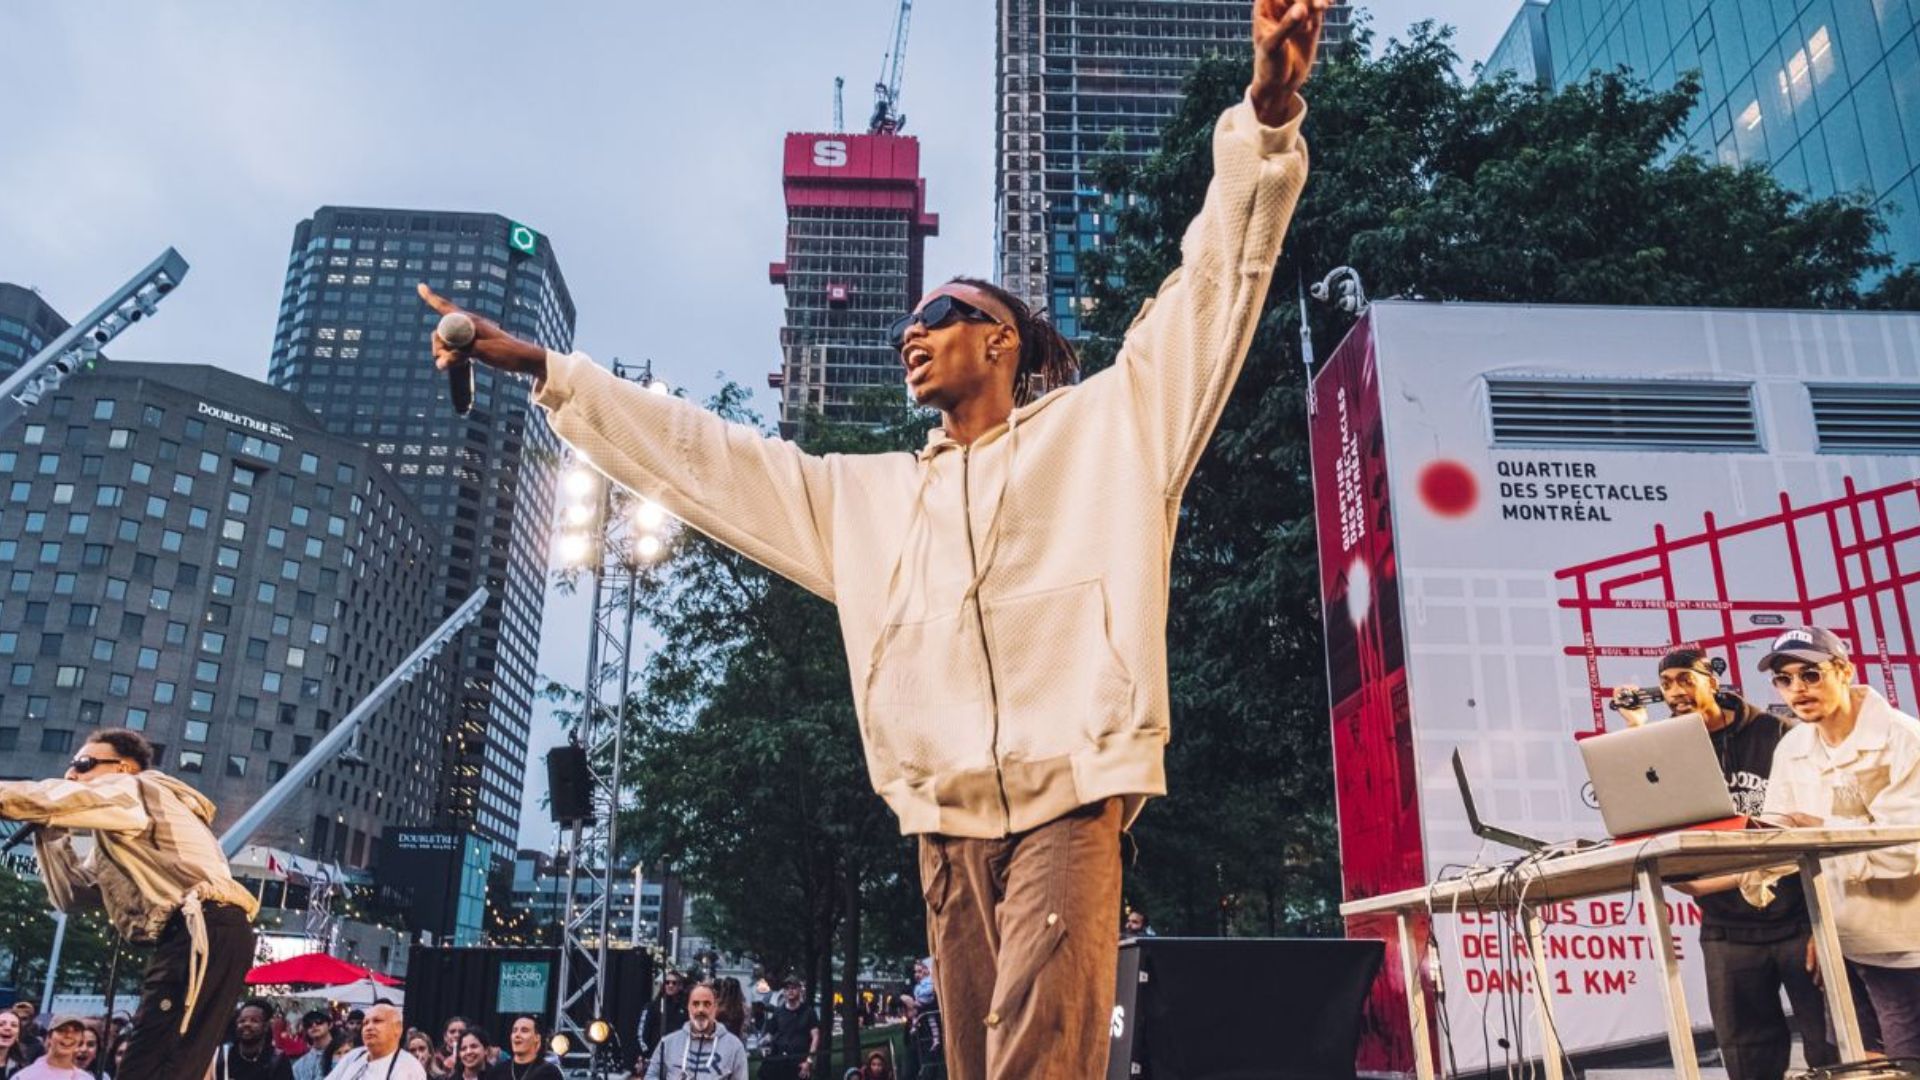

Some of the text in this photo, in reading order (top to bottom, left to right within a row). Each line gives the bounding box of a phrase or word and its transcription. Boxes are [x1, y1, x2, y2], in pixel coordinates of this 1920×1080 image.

[813, 140, 847, 167] S
[1338, 386, 1358, 546] DES SPECTACLES
[1497, 461, 1597, 478] QUARTIER
[1500, 482, 1668, 501] DES SPECTACLES
[1335, 457, 1350, 552] QUARTIER
[1502, 500, 1612, 521] MONTRÉAL
[1590, 901, 1627, 925] DE
[1463, 934, 1499, 959] DE
[1555, 970, 1573, 994] 1
